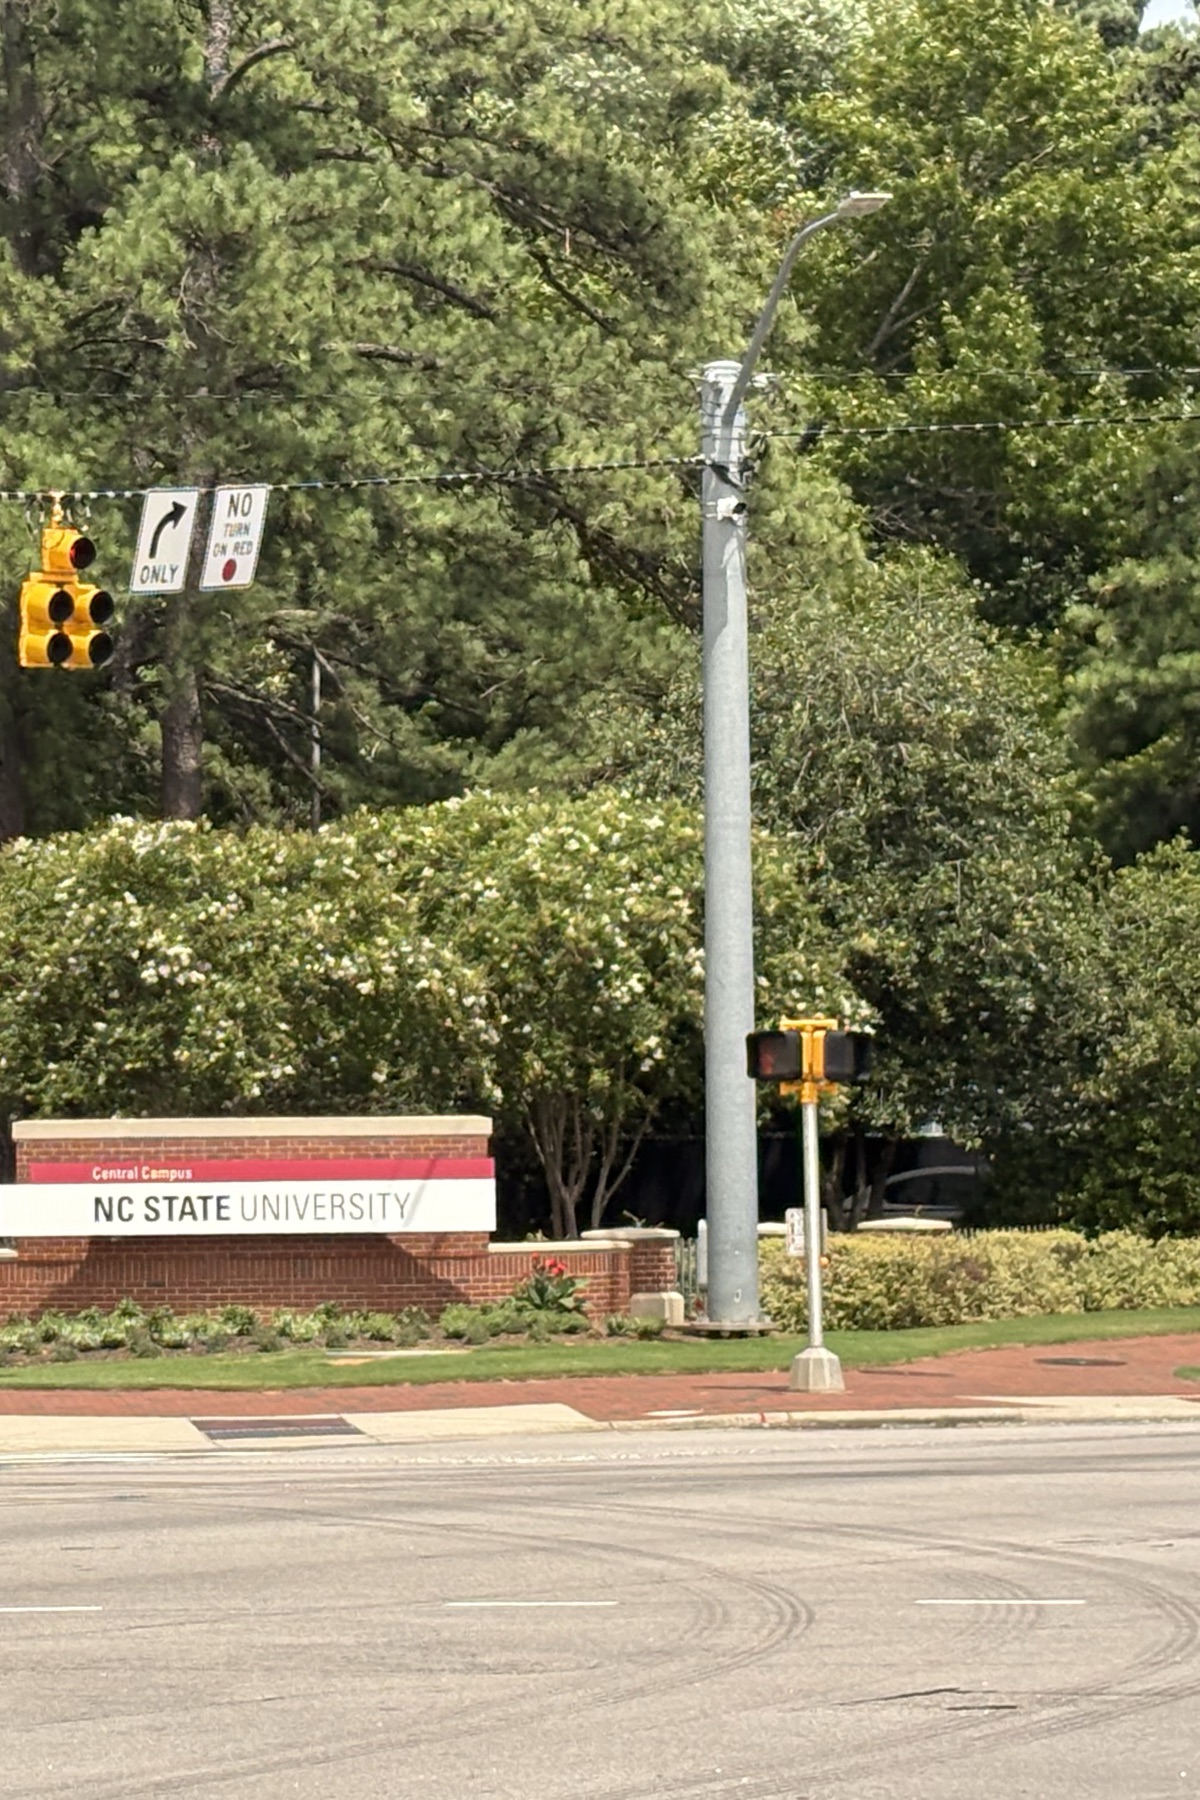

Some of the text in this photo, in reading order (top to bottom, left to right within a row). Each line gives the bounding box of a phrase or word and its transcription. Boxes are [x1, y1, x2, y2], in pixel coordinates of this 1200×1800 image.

[227, 492, 253, 518] NO
[224, 522, 251, 537] TURN
[212, 541, 254, 557] ON RED
[139, 564, 179, 584] ONLY
[92, 1165, 193, 1182] Central Campus
[94, 1192, 411, 1222] NC STATE UNIVERSITY
